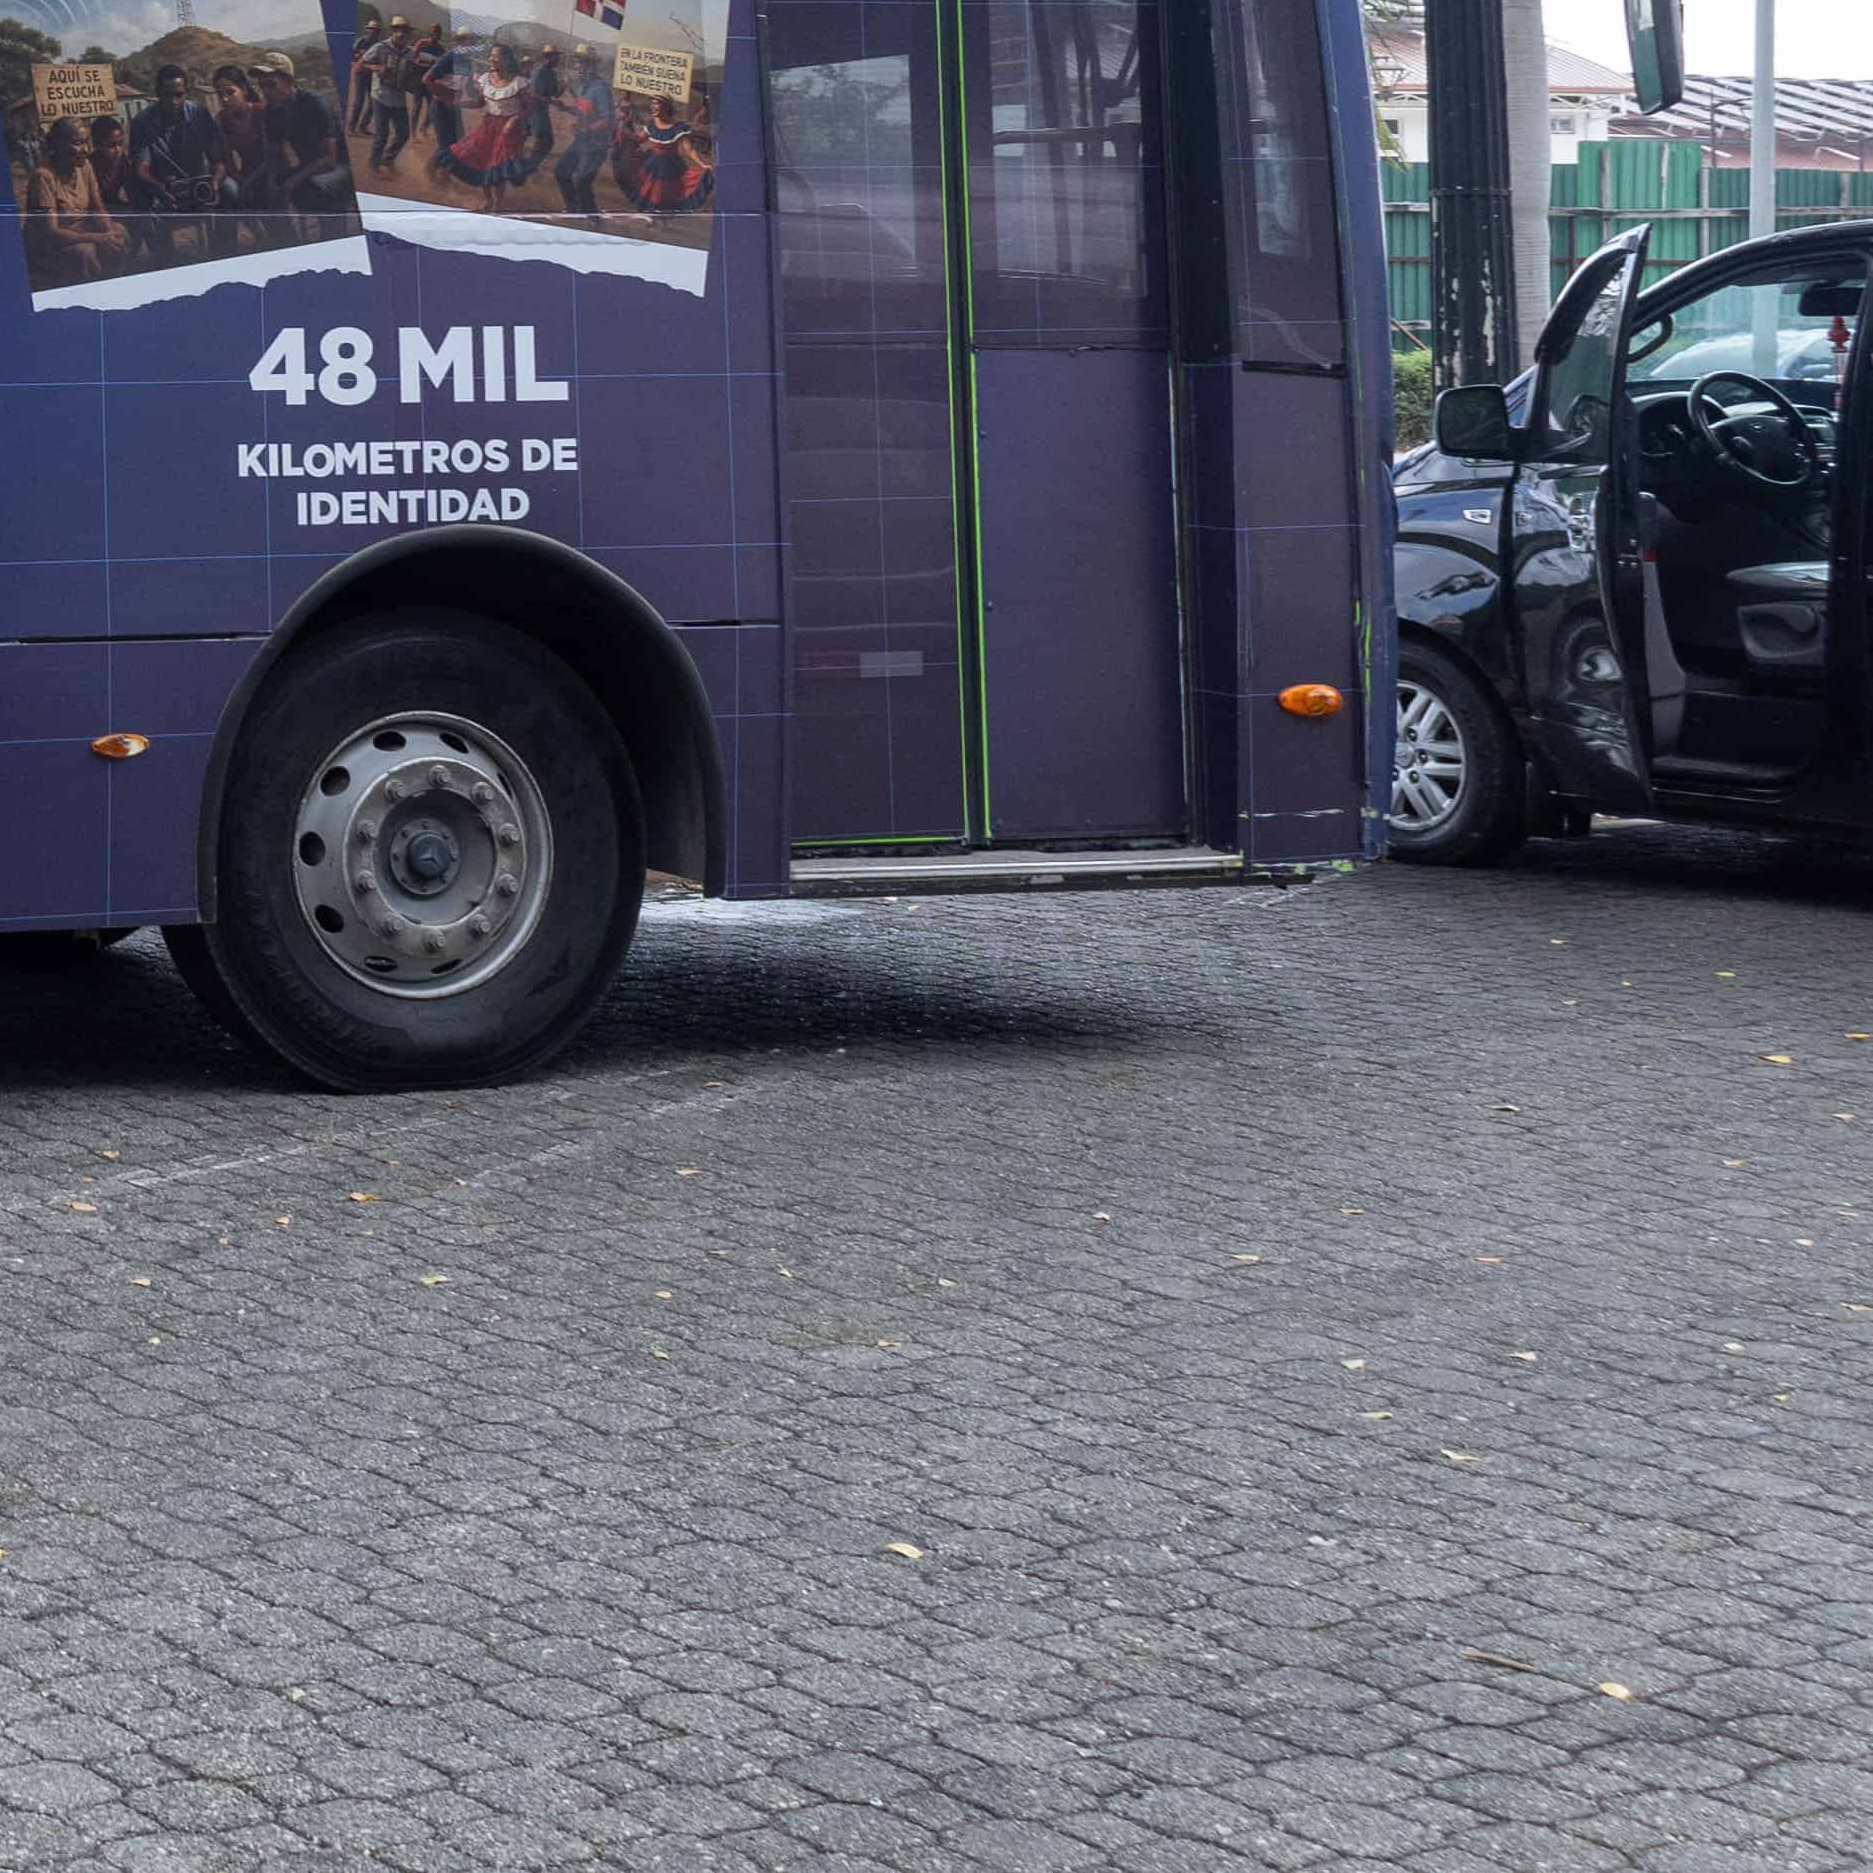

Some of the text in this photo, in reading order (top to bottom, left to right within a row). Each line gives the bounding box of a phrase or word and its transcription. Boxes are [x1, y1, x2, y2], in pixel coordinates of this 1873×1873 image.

[644, 52, 686, 67] FRONTERA
[84, 70, 101, 82] SE
[656, 67, 686, 80] SUENA
[620, 73, 682, 95] LO NUESTRO
[47, 85, 105, 100] ESCUCHA
[41, 100, 114, 116] LO NUESTRO
[248, 325, 570, 406] 48 MIL
[237, 437, 579, 478] KILOMETROS DE
[297, 487, 531, 526] IDENTIDAD
